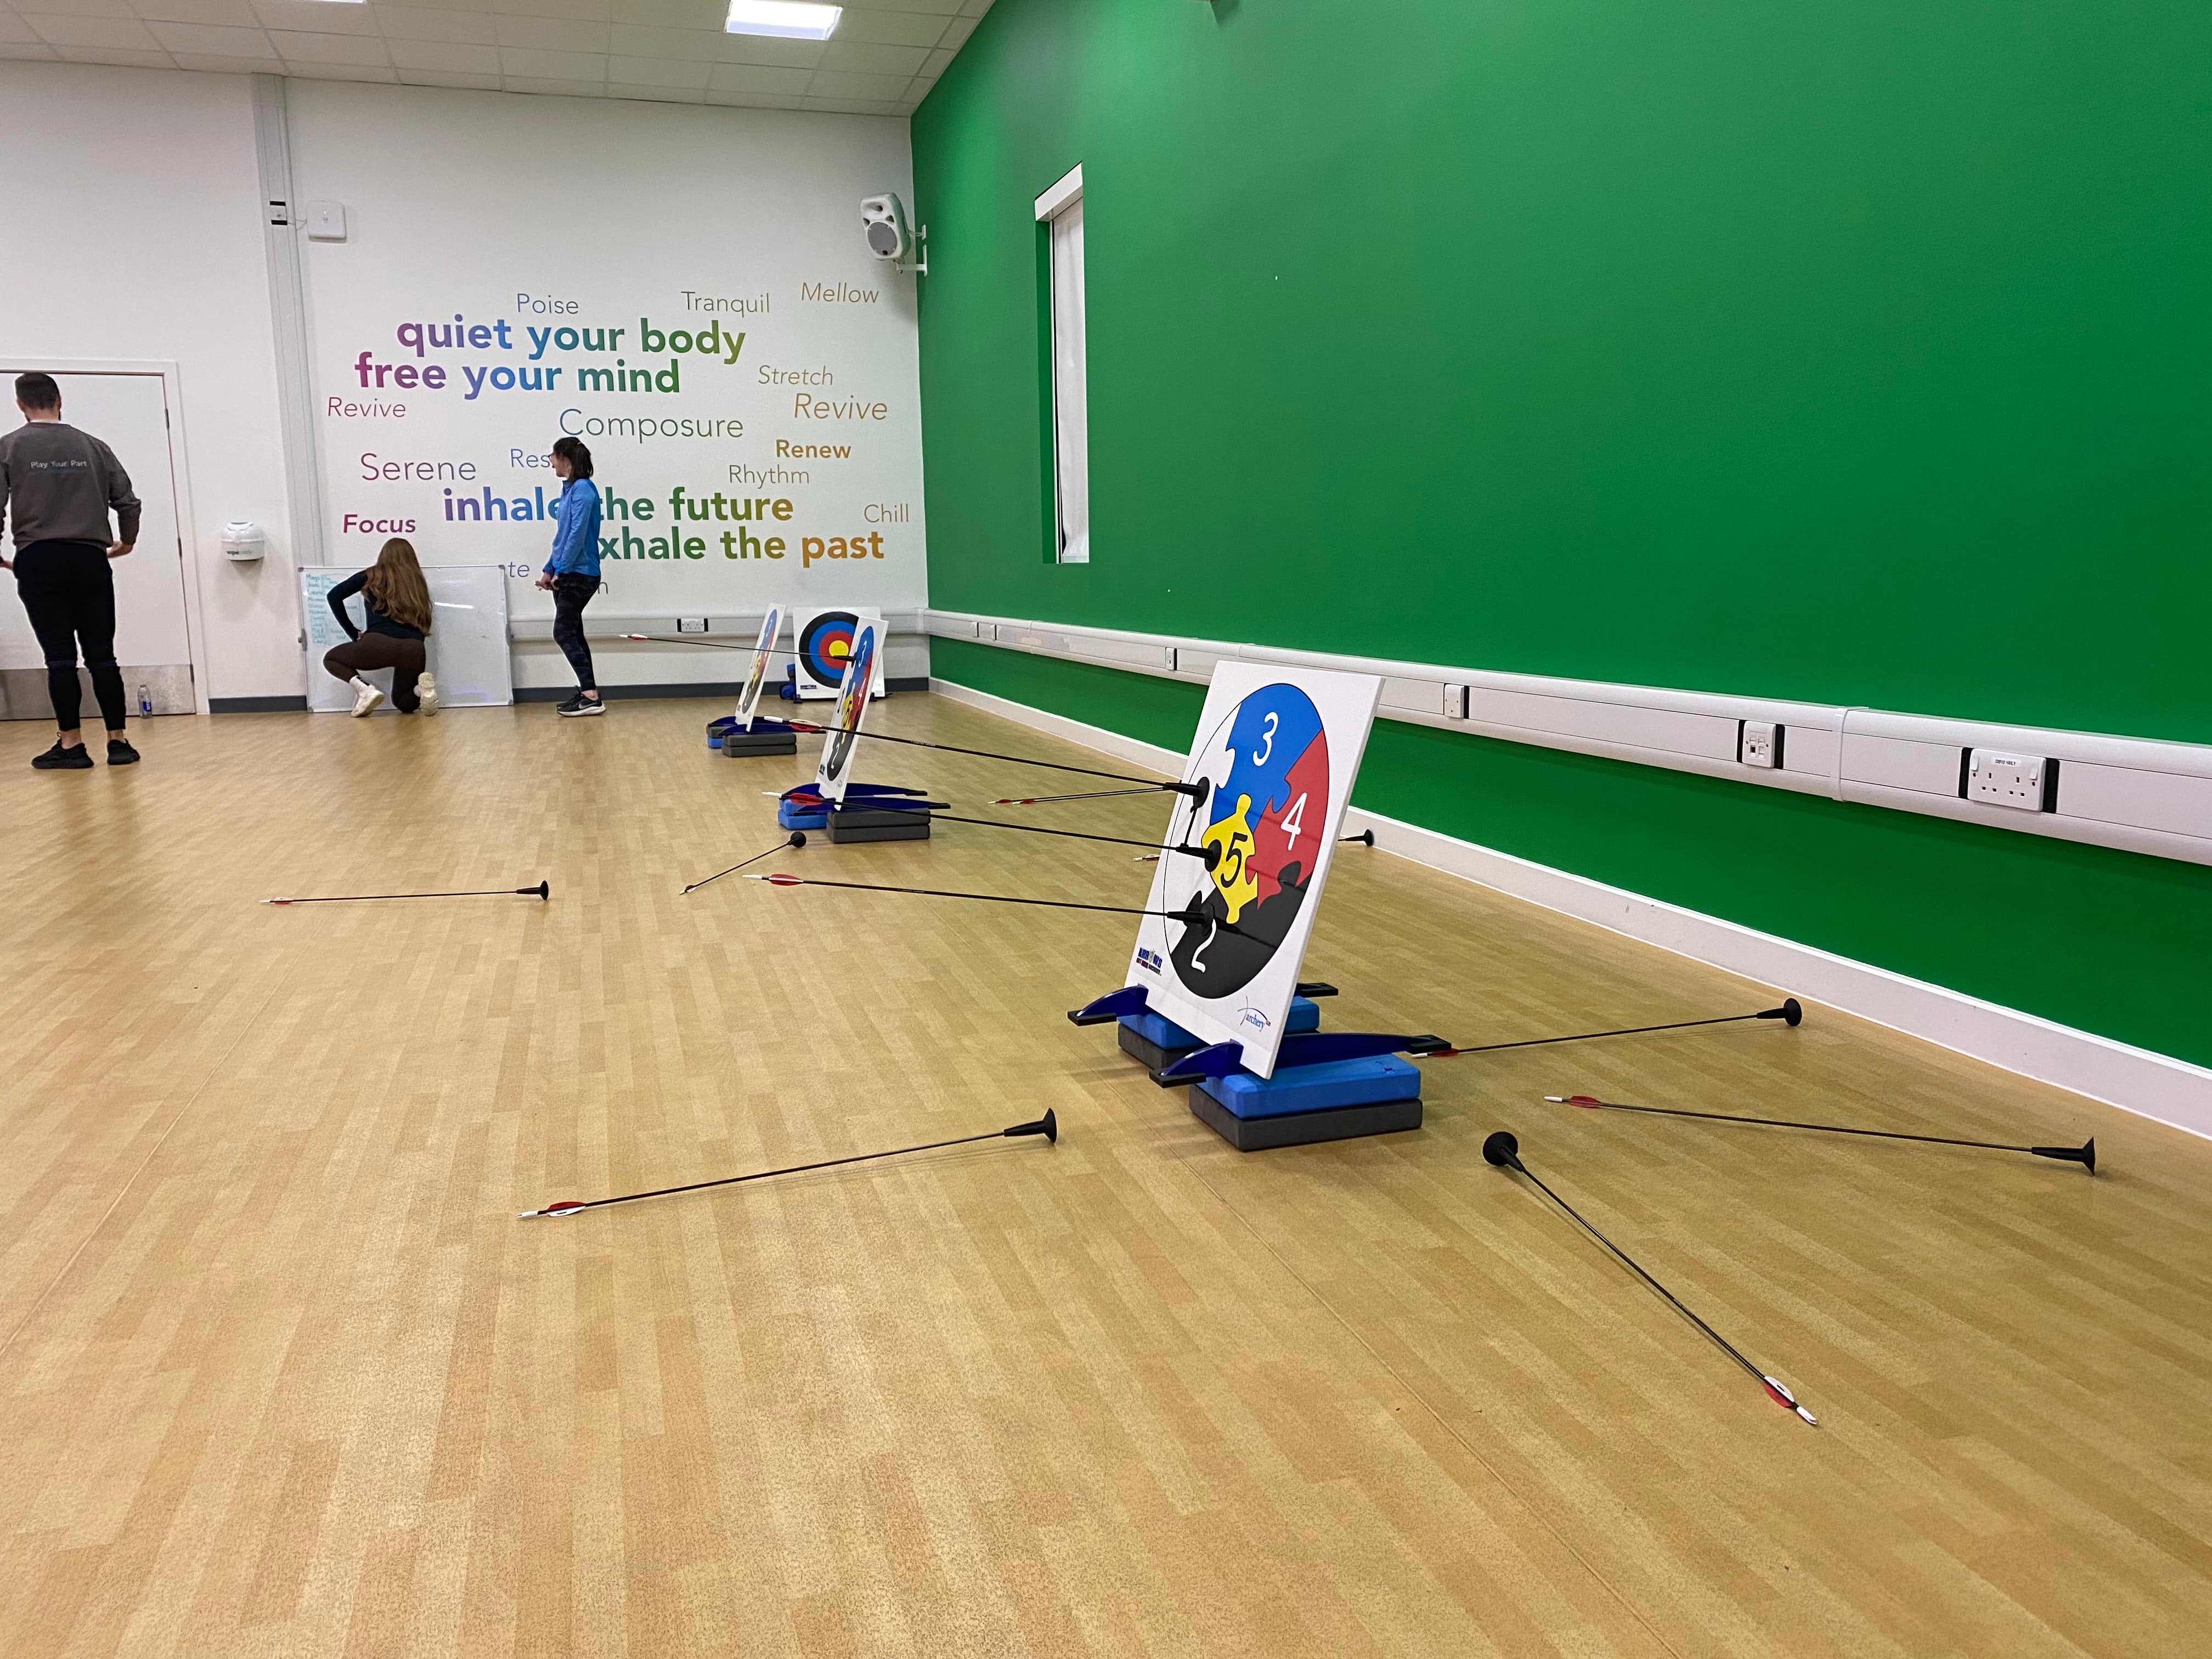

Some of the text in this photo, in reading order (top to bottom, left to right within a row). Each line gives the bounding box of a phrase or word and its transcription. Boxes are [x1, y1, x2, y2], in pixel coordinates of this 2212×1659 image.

[517, 293, 579, 314] Poise
[681, 291, 770, 317] Tranquil
[801, 283, 879, 303] Mellow
[398, 314, 746, 364] quiet your body
[354, 352, 680, 399] free your mind
[758, 365, 833, 386] Stretch
[328, 397, 406, 417] Revive
[794, 393, 888, 420] Revive
[560, 409, 743, 443] Composure
[511, 449, 551, 468] Res
[776, 439, 851, 458] Renew
[361, 453, 476, 480] Serene
[729, 465, 810, 489] Rhythm
[669, 487, 793, 521] future
[864, 504, 909, 523] Chill
[343, 514, 416, 533] Focus
[600, 526, 884, 567] xhale the past
[1252, 712, 1279, 767] 3
[1281, 793, 1306, 851] 4
[1221, 832, 1248, 888] 5
[1245, 1014, 1265, 1031] archery
